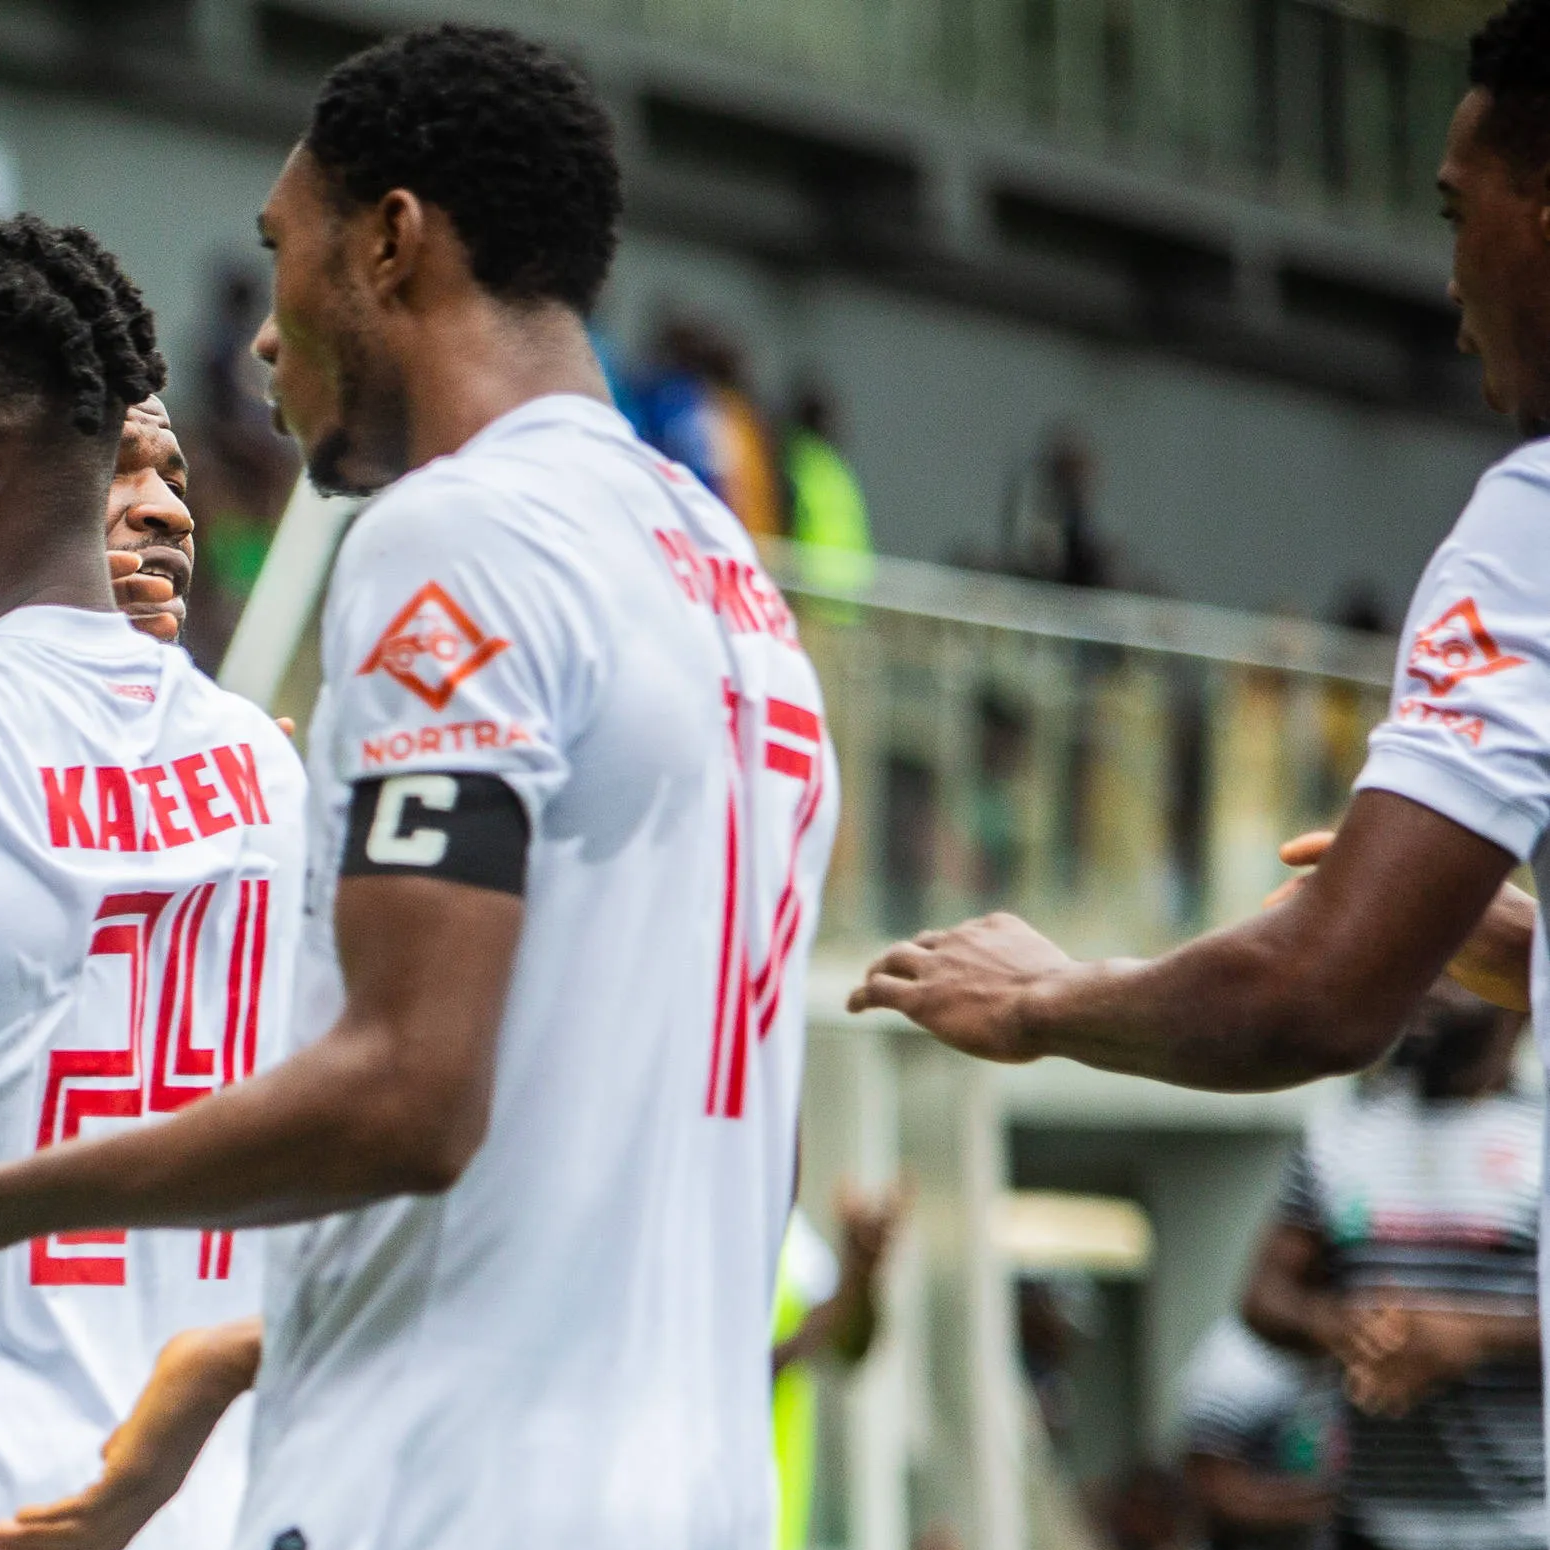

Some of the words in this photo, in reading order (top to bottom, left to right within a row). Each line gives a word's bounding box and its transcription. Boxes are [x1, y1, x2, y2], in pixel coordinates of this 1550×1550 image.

[361, 720, 534, 769] NORTRA
[366, 776, 457, 868] C
[30, 879, 270, 1287] 24
